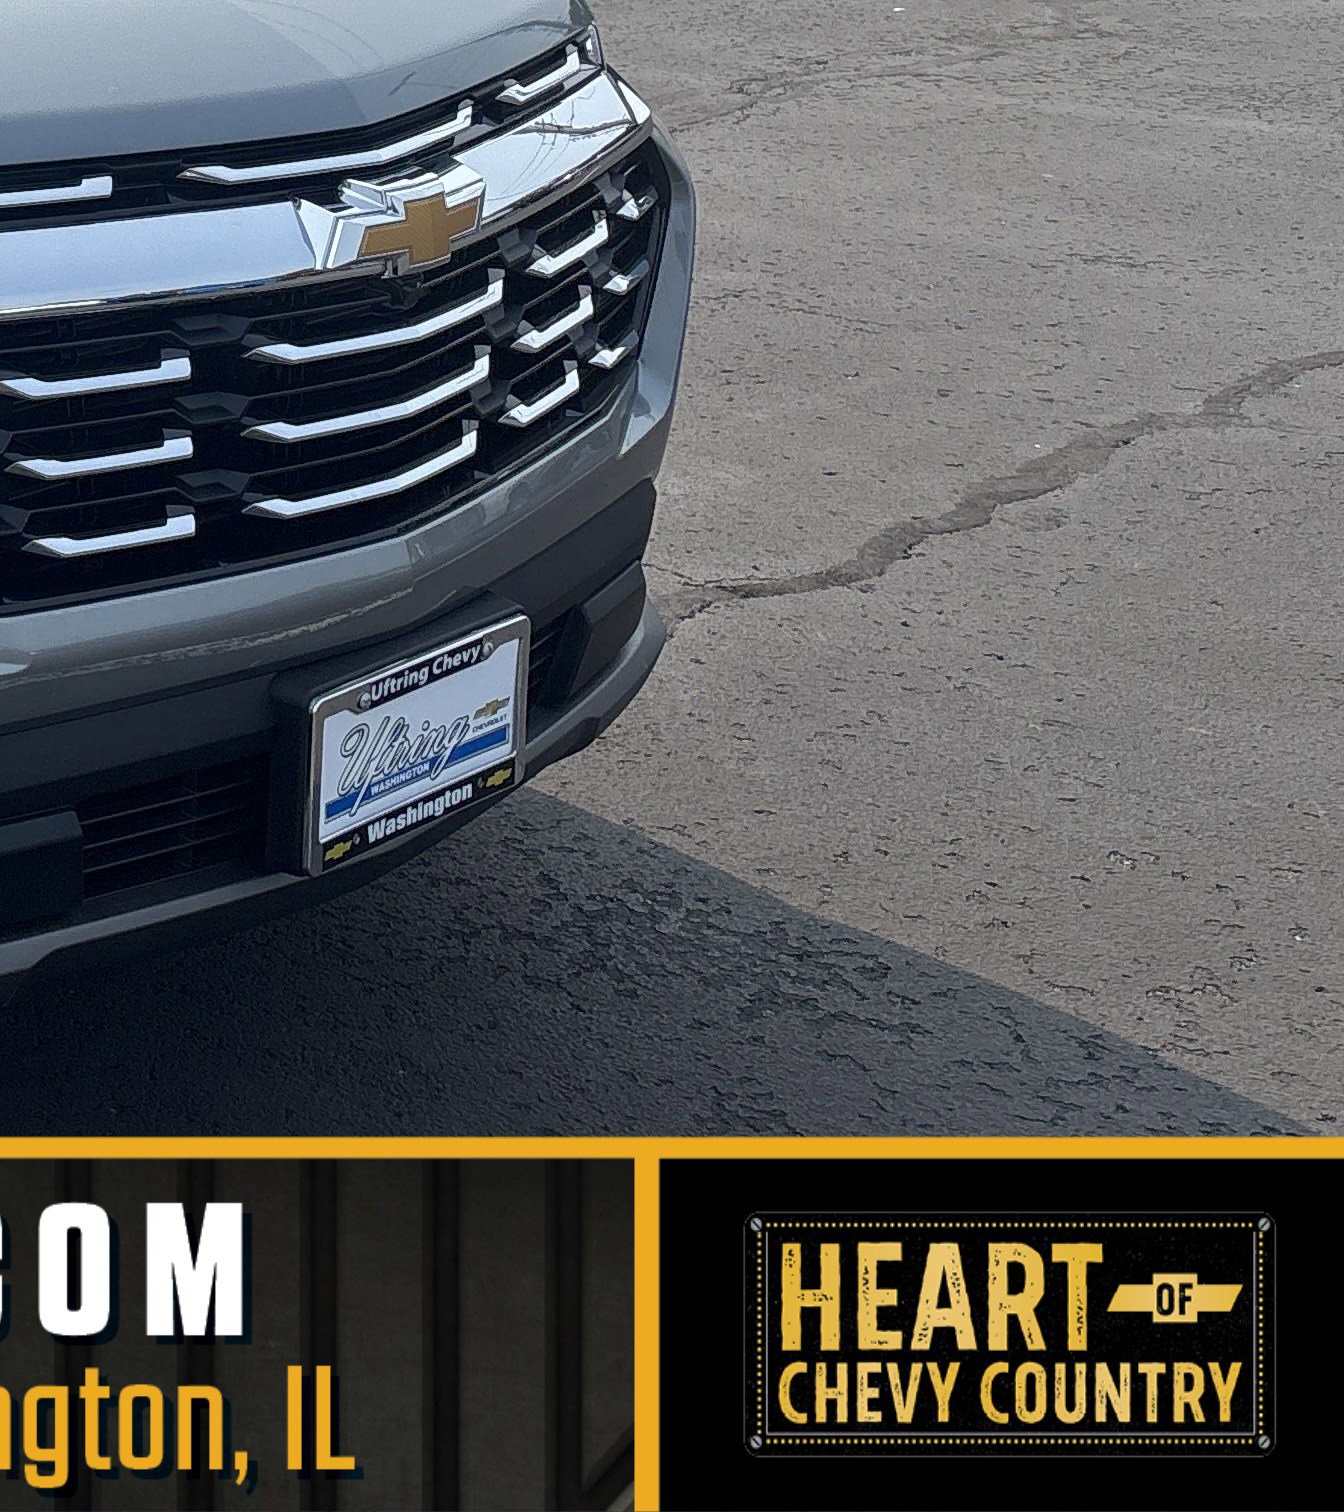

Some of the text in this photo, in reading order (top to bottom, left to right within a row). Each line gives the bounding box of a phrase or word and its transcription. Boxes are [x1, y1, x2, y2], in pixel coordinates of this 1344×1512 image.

[371, 644, 482, 702] Uftring Chevy
[472, 713, 508, 733] CHEVROLET
[337, 714, 470, 817] Uftring
[370, 762, 431, 796] WASHINGTON
[367, 783, 473, 844] Washington
